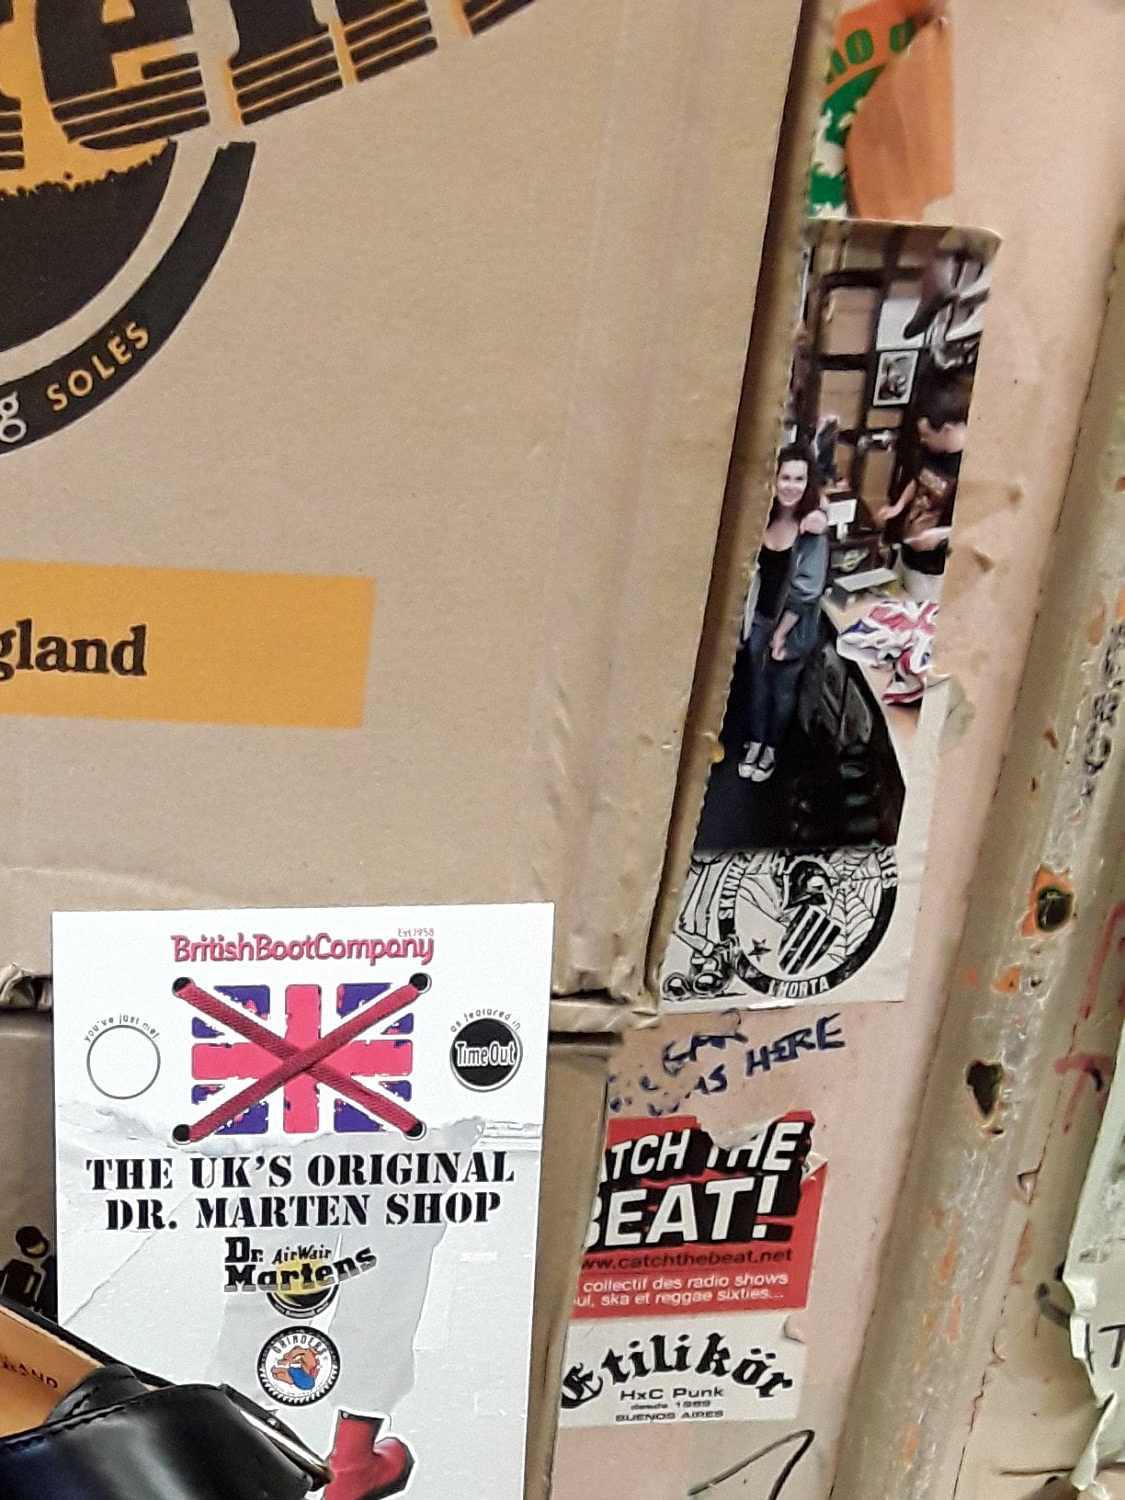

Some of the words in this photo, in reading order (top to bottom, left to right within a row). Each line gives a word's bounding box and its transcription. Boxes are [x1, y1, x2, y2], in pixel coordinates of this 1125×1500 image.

[45, 319, 150, 412] SOLES
[172, 931, 435, 966] BritishBootCompany
[745, 1012, 845, 1078] HERE
[86, 1158, 173, 1191] THE
[307, 1151, 515, 1186] ORIGINAL
[106, 1198, 178, 1231] DR.
[196, 1196, 369, 1229] MARTEN
[386, 1190, 501, 1225] SHOP
[224, 1236, 264, 1264] Dr.
[271, 1243, 333, 1265] AirWair
[223, 1246, 378, 1293] Martens
[583, 1280, 647, 1293] collectif
[652, 1277, 683, 1291] des
[687, 1274, 729, 1290] radio
[734, 1272, 789, 1287] shows
[601, 1293, 630, 1307] ska
[634, 1292, 651, 1304] et
[655, 1290, 713, 1306] reggae
[620, 1389, 664, 1400] HxC
[672, 1386, 724, 1399] Punk
[615, 1412, 675, 1422] BUENOS
[681, 1410, 724, 1419] AIRES
